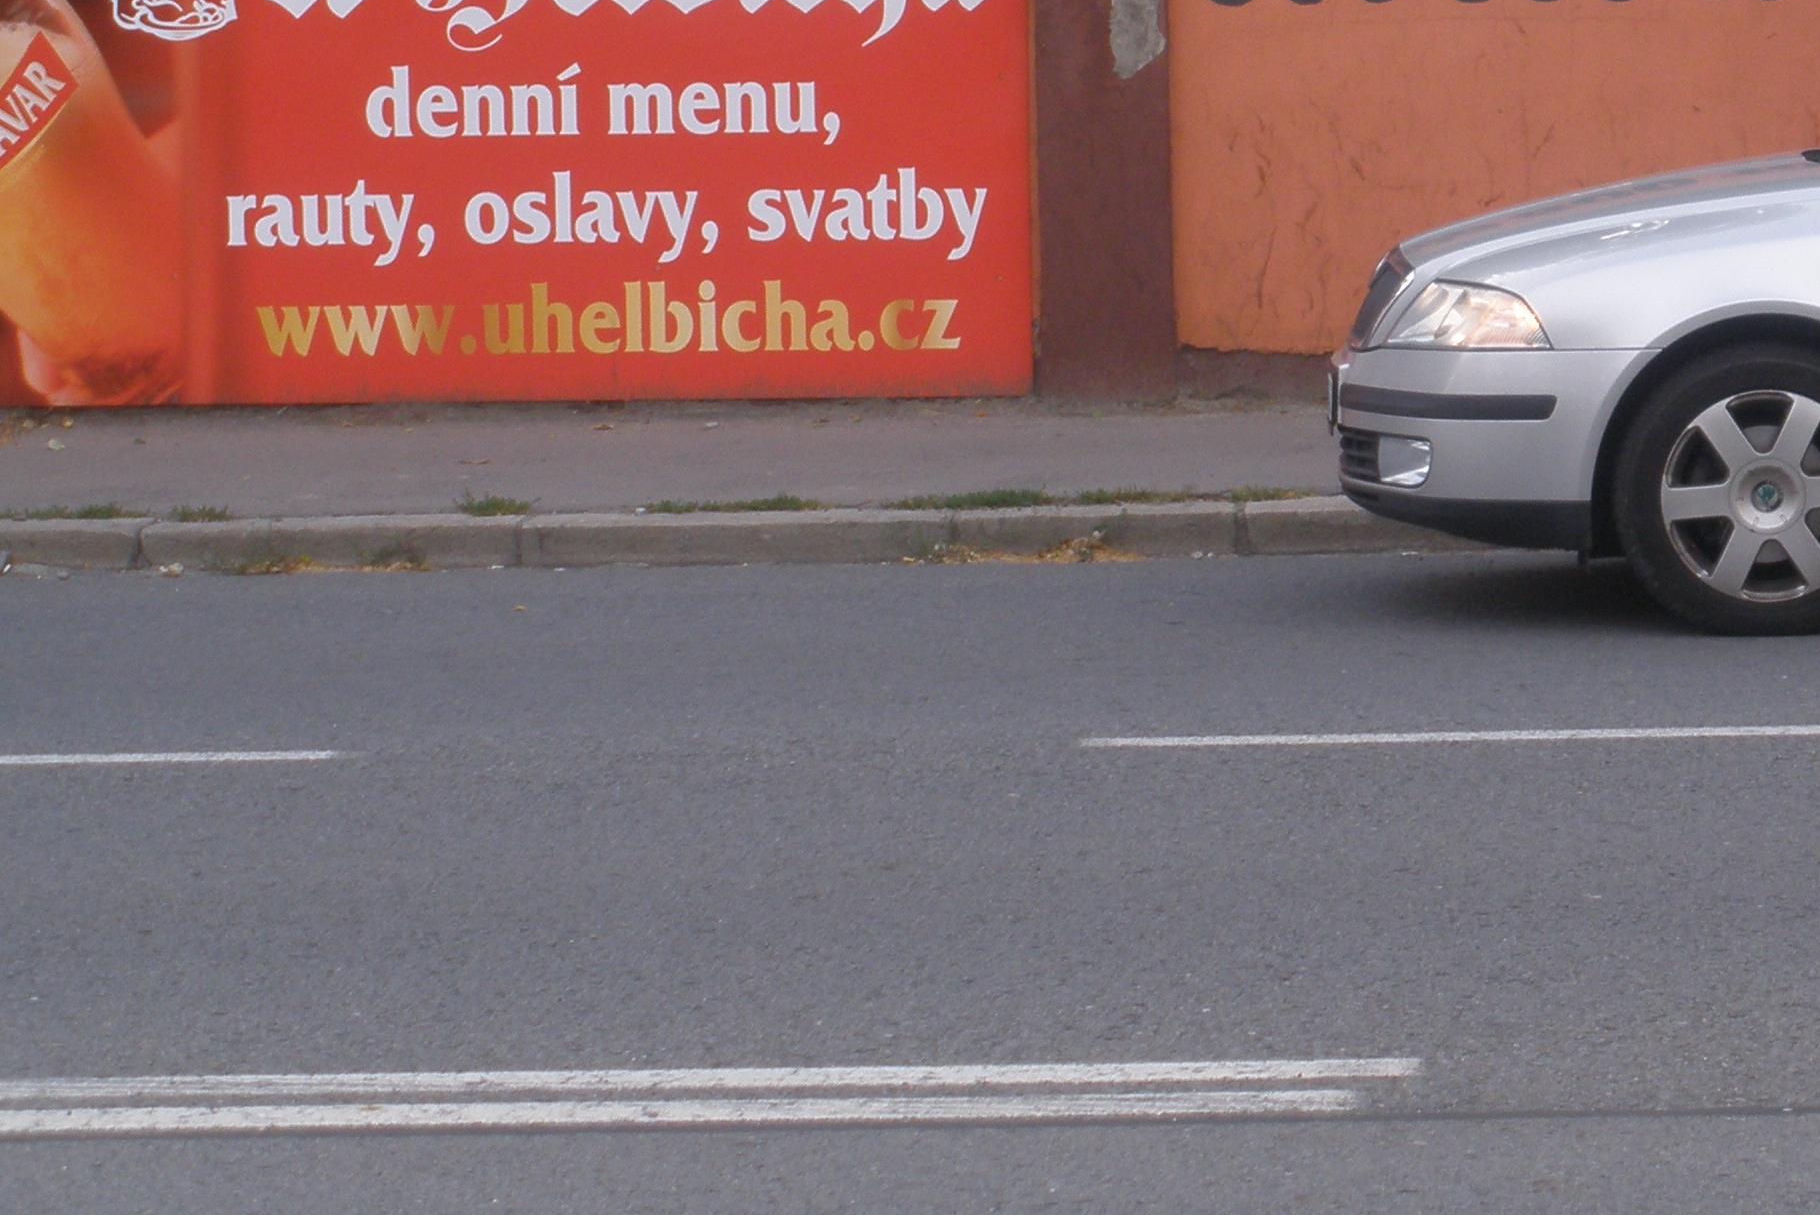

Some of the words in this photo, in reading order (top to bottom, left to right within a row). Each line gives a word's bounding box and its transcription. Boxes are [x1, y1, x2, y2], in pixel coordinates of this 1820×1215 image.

[365, 62, 580, 140] denní
[607, 80, 840, 144] menu,
[225, 178, 435, 266] rauty,
[464, 171, 718, 263] oslavy,
[746, 168, 988, 260] svatby
[257, 280, 962, 358] www.uhelbicha.cz
